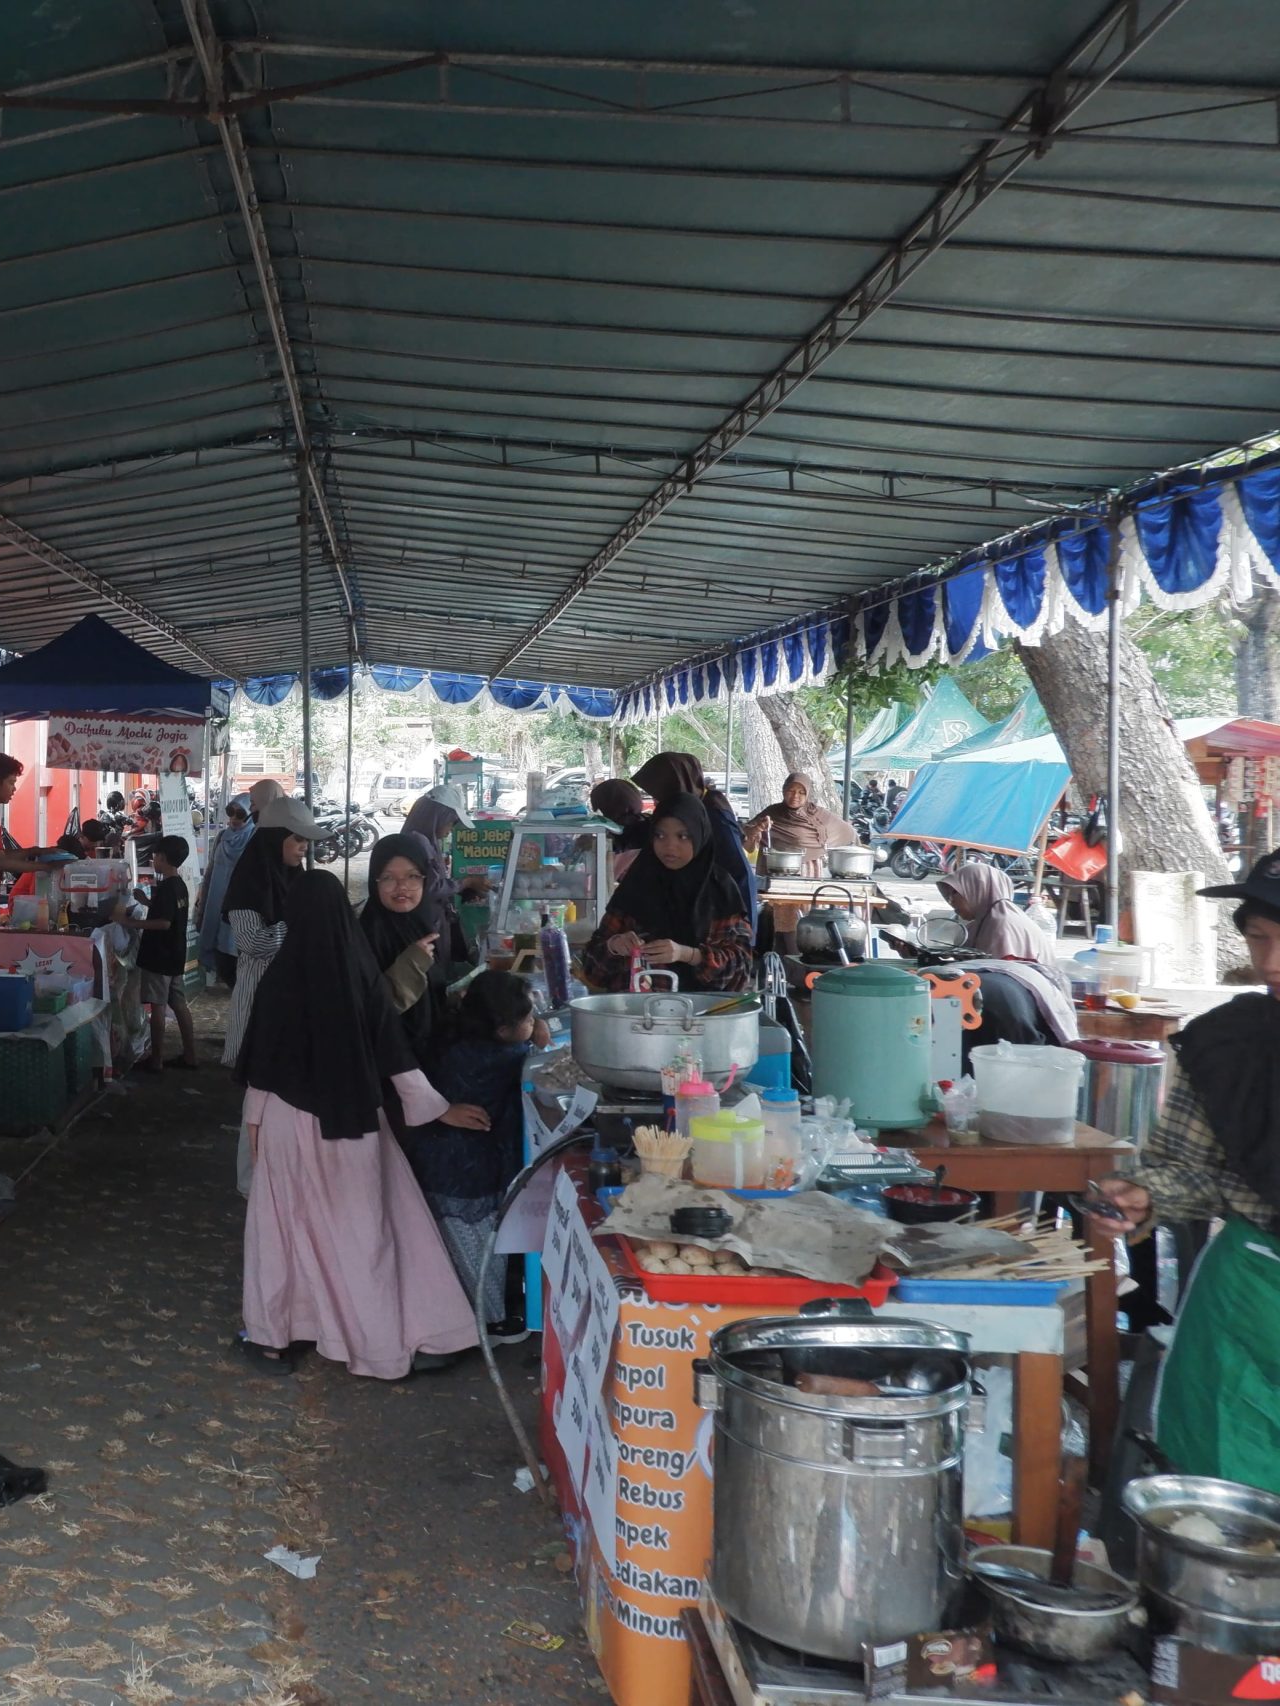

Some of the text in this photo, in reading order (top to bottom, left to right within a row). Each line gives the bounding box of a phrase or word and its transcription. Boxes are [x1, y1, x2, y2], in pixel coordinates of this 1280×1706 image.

[64, 721, 113, 737] Daifuku
[116, 726, 153, 740] Mochi
[156, 727, 189, 744] Jogja
[456, 829, 478, 843] Mie
[627, 1323, 695, 1350] Tusuk
[614, 1434, 697, 1478] oreng/
[619, 1477, 684, 1510] Rebus
